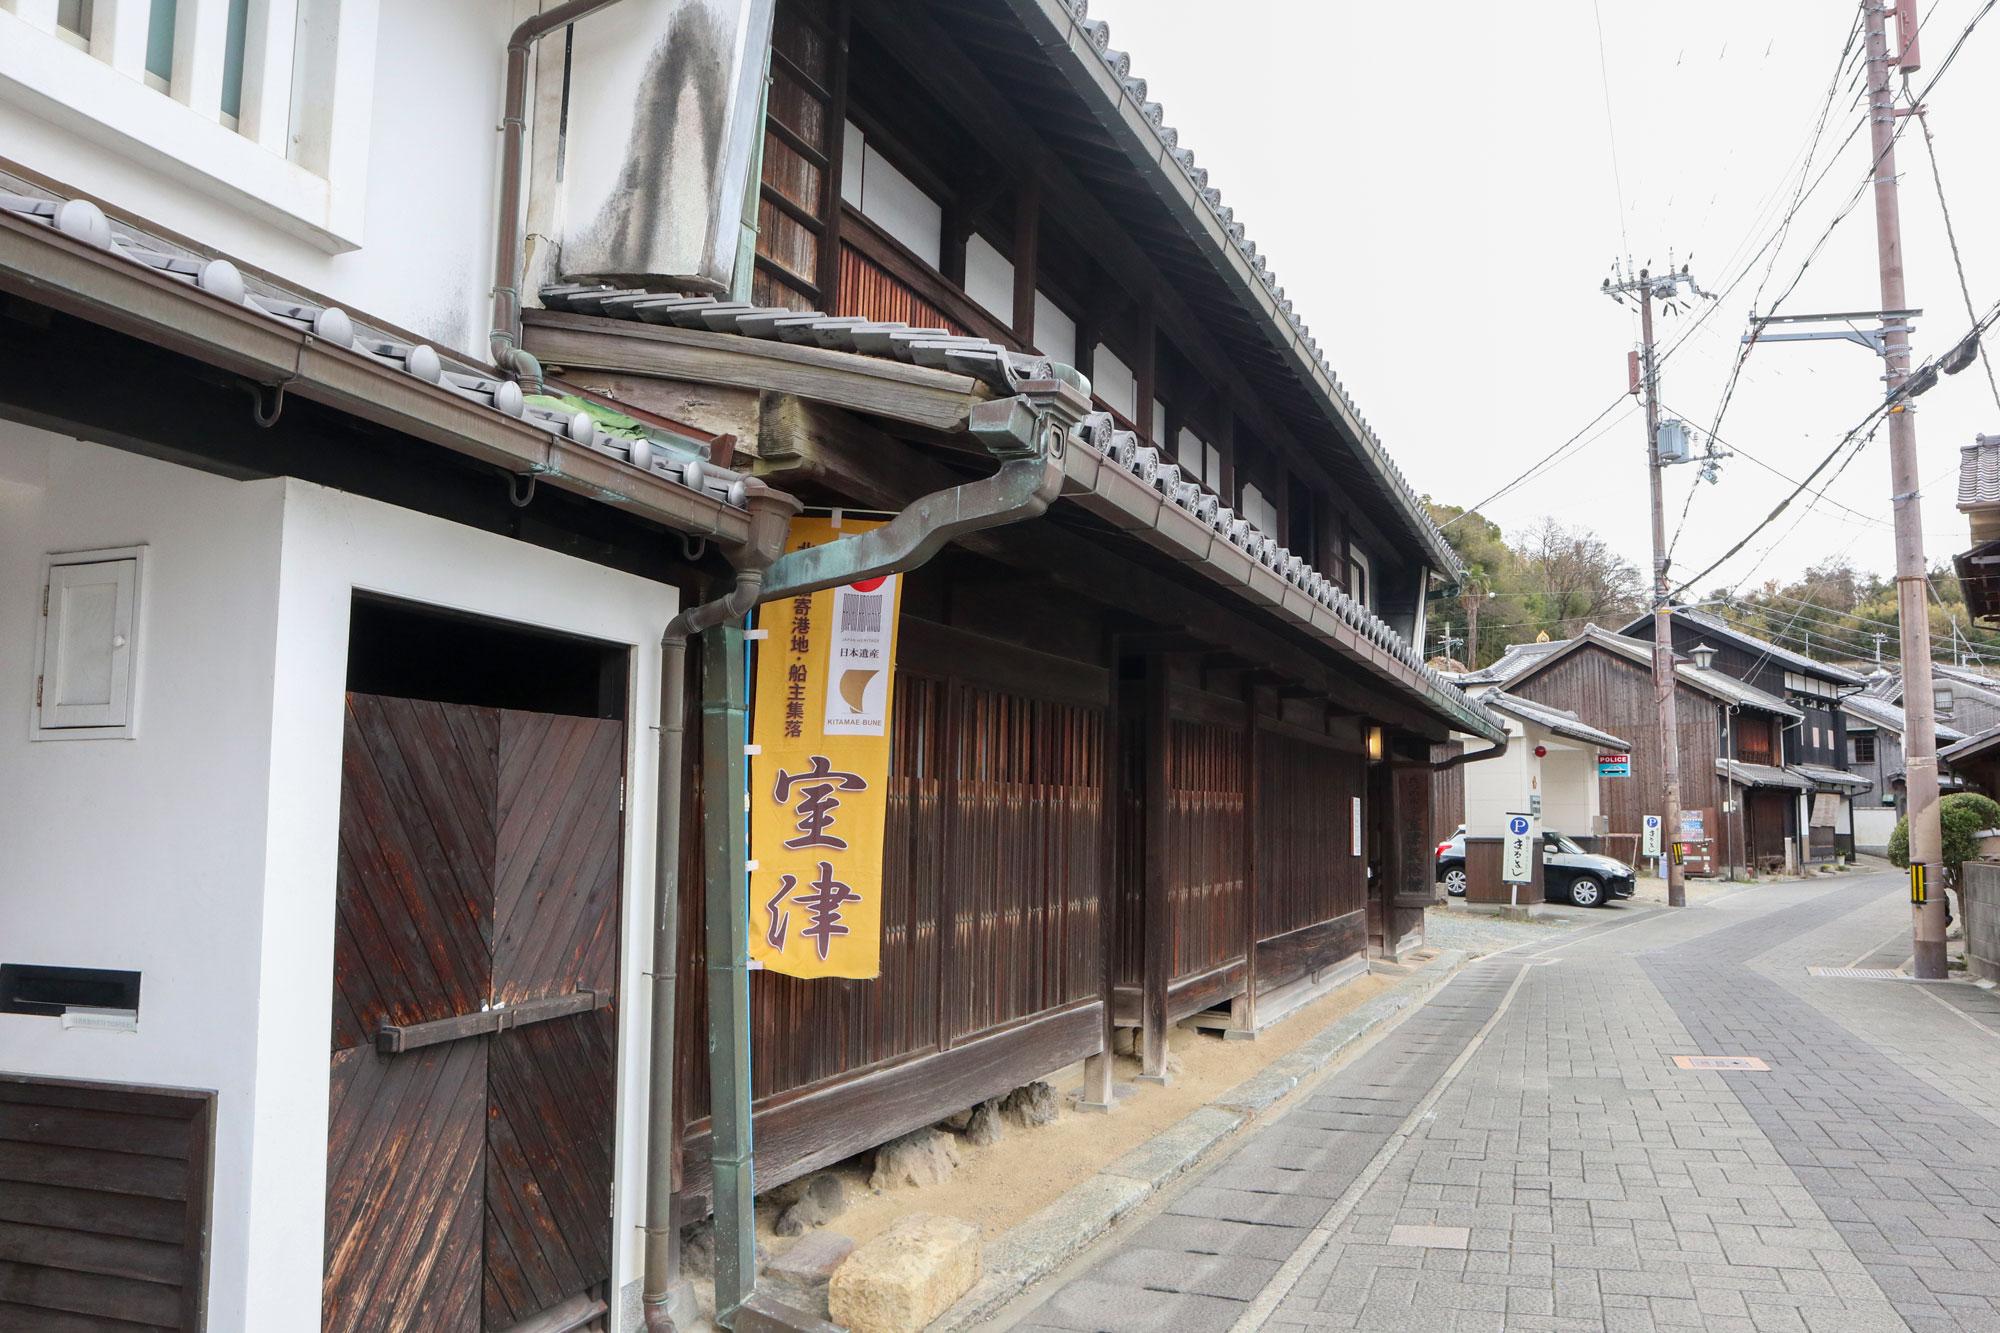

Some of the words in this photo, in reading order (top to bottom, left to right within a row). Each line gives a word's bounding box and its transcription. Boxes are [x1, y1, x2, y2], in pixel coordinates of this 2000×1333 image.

[784, 542, 815, 738] 寄港地・船主集落
[840, 648, 880, 659] 日本遺産
[1514, 819, 1526, 833] P
[1648, 818, 1656, 827] P
[766, 755, 868, 961] 室津
